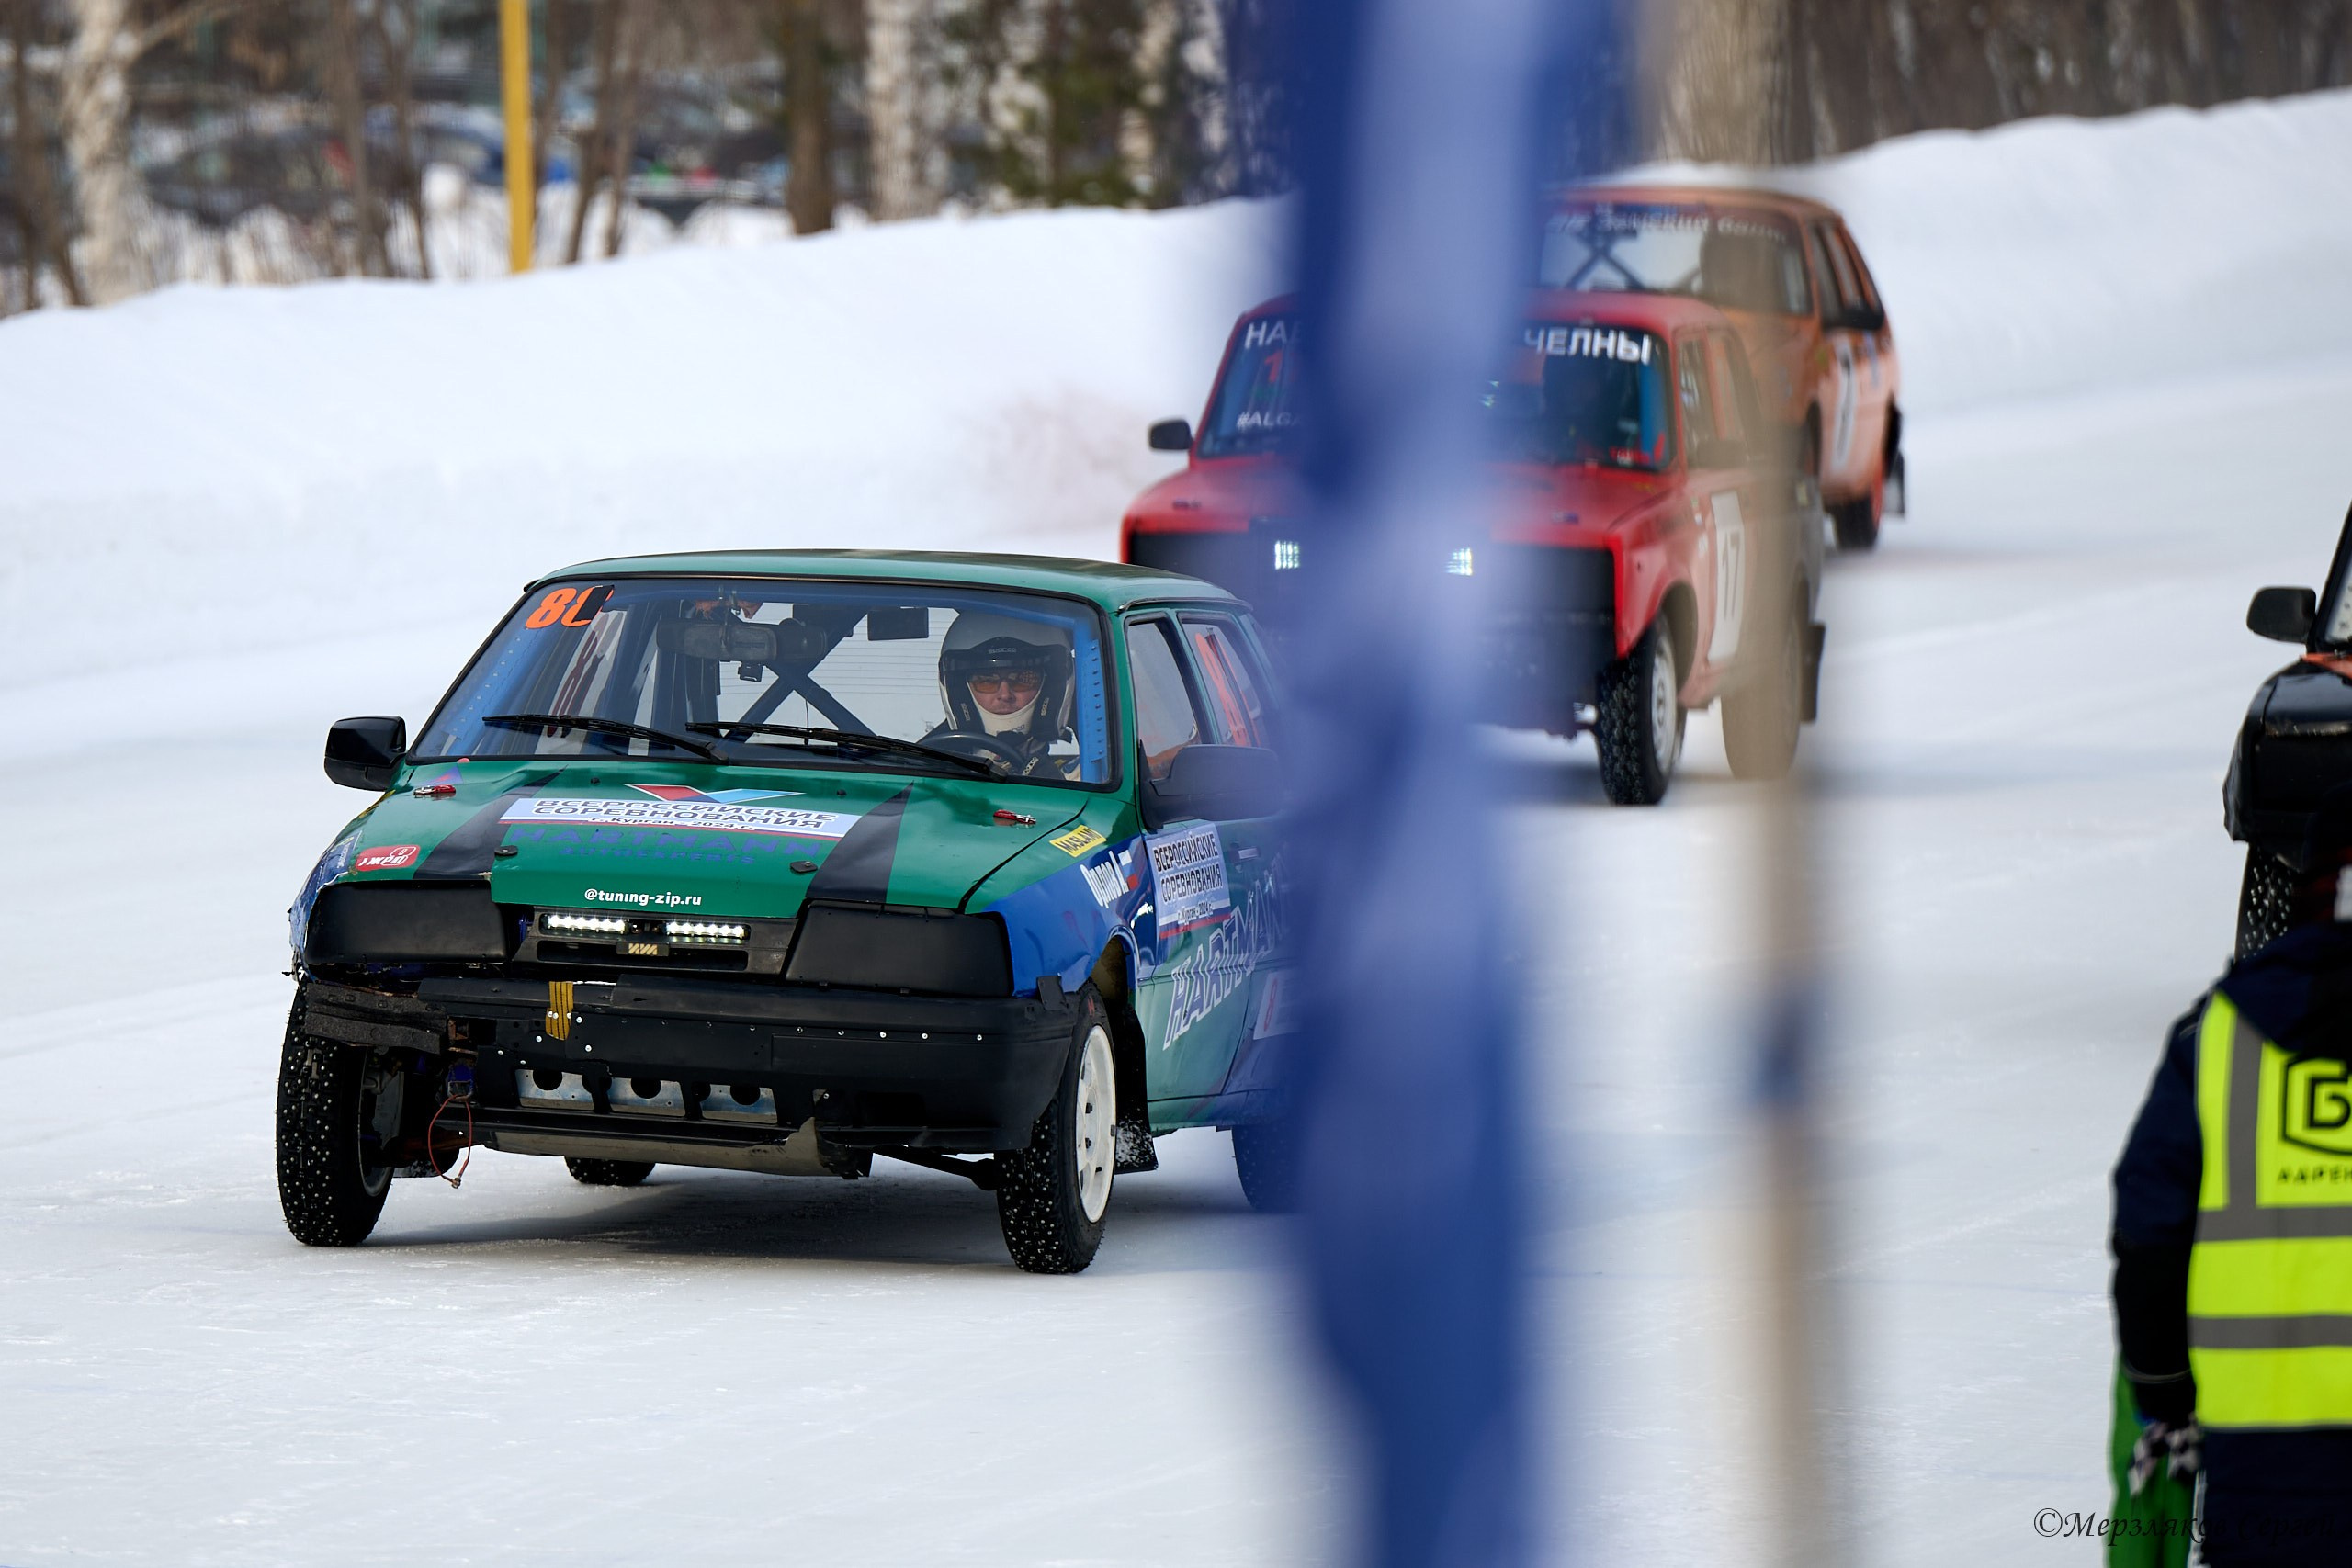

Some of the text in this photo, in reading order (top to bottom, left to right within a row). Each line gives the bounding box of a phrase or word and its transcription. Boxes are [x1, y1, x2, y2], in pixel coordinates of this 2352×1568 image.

[1525, 326, 1652, 366] ЧЕЛНЫ
[1722, 530, 1741, 621] 17
[534, 807, 823, 829] СОРЕВНОВАНИЯ
[536, 800, 837, 821] ВСЕРОССИЙСКИЕ
[510, 828, 822, 857] HARTMANN
[1153, 832, 1218, 873] ВСЕРОССИЙСКИЕ
[584, 888, 702, 908] @tuning-zip.ru
[1160, 863, 1223, 902] СОРЕВНОВАНИЯ
